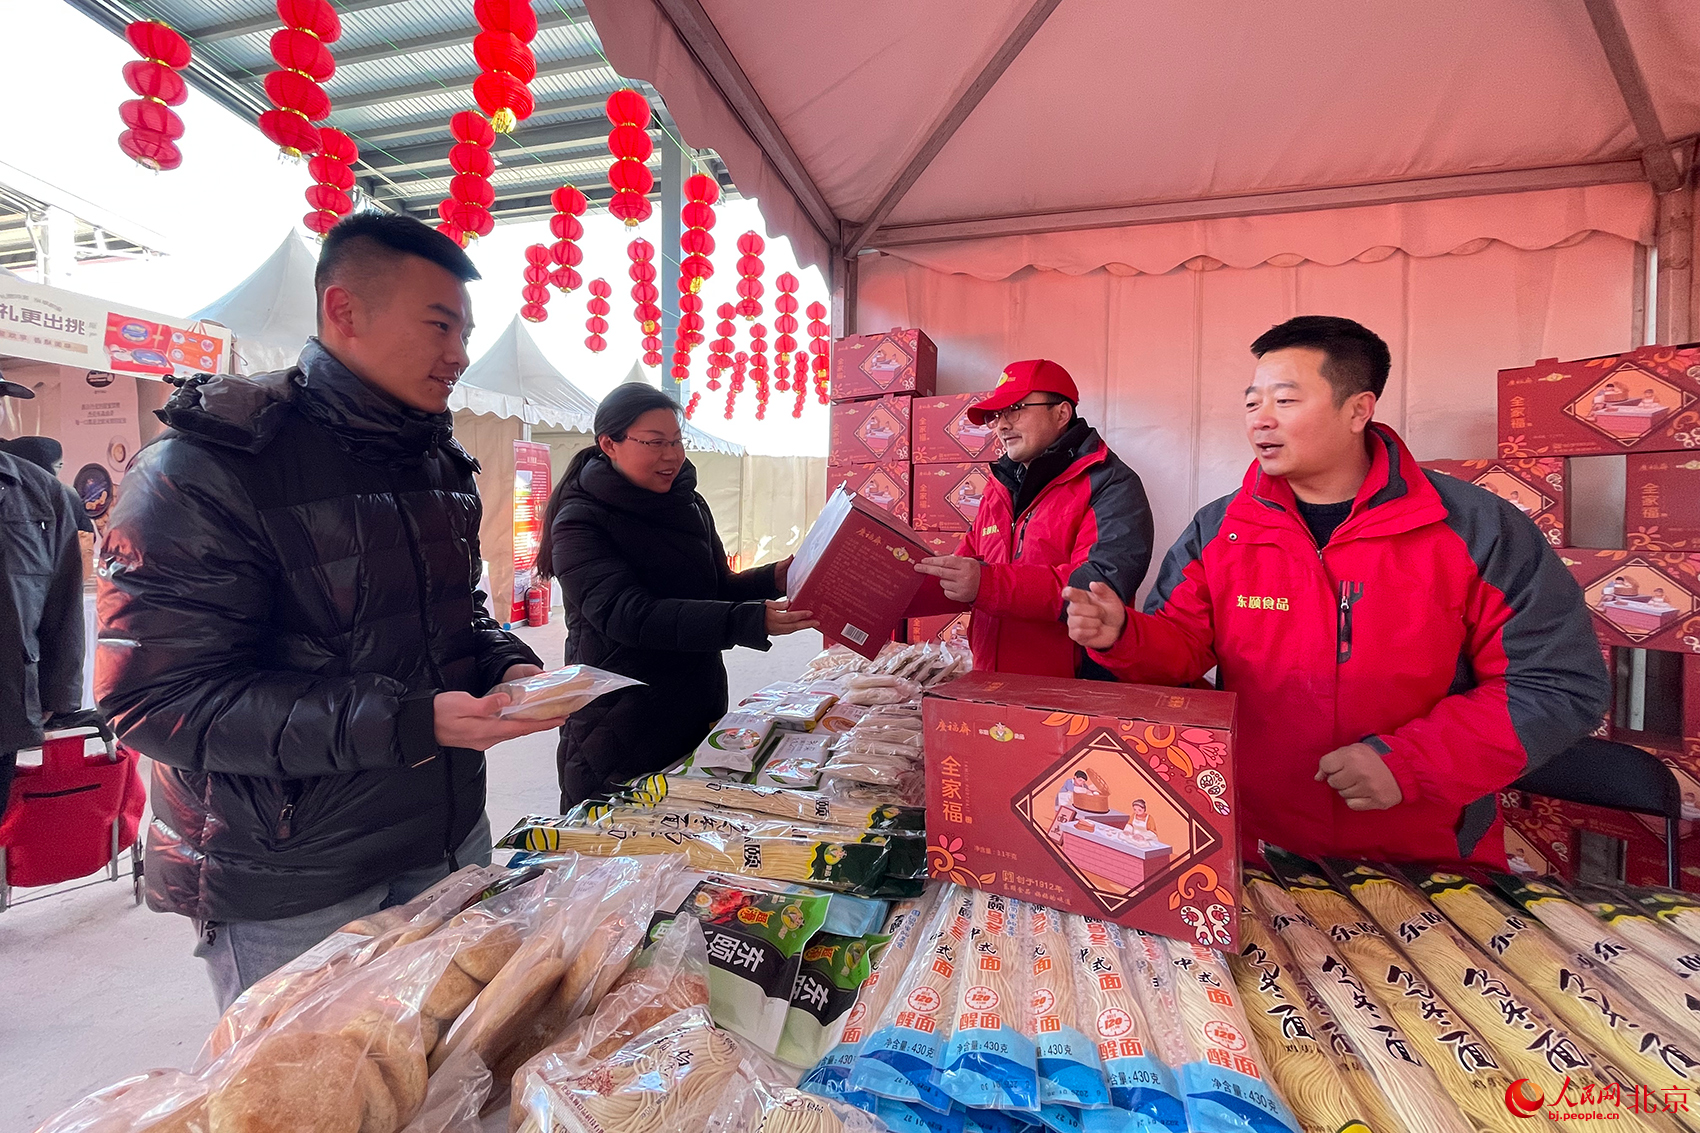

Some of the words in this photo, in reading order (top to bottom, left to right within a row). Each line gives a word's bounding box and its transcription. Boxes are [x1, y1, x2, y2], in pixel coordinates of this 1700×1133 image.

[0, 303, 85, 335] 礼更出挑
[1510, 396, 1525, 428] 全家福
[1641, 483, 1659, 518] 全家福
[1236, 594, 1290, 611] 东颐食品
[941, 755, 963, 823] 全家福
[704, 930, 764, 973] 东颐
[971, 994, 991, 1002] 120
[1173, 958, 1233, 1007] 中式面
[895, 1012, 937, 1033] 醒面
[959, 1012, 1001, 1031] 醒面
[1099, 1038, 1144, 1060] 醒面
[1206, 1049, 1261, 1080] 醒面
